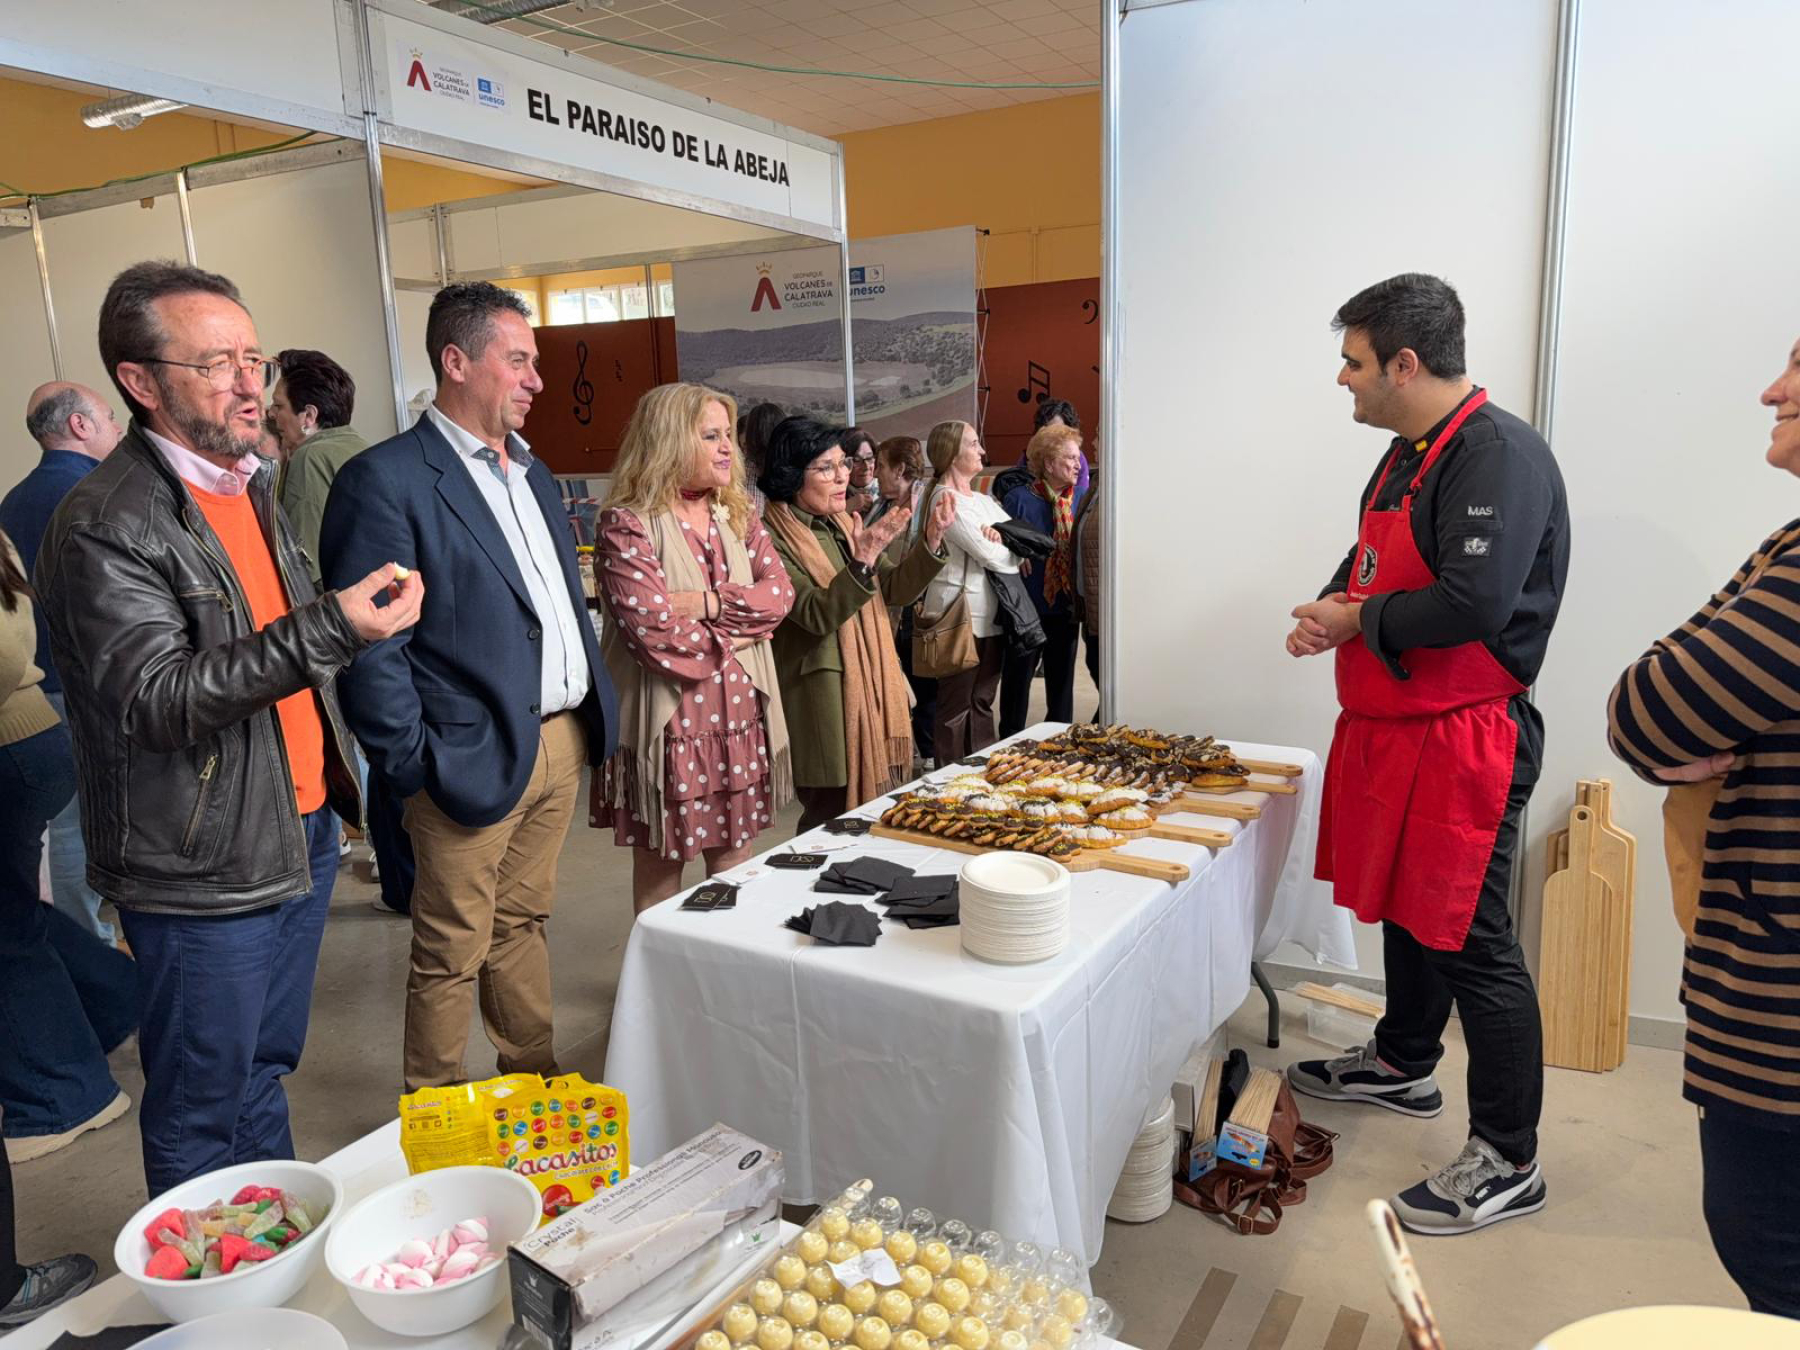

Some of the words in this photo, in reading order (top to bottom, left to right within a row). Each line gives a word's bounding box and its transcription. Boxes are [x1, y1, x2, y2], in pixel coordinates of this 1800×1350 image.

[432, 72, 463, 86] VOLCANES
[433, 80, 470, 96] CALATRAVA
[479, 94, 505, 106] unesco
[527, 88, 559, 126] EL
[566, 99, 666, 153] PARAISO
[672, 130, 699, 163] DE
[704, 139, 729, 171] LA
[734, 148, 790, 187] ABEJA
[784, 280, 826, 290] VOLCANES
[784, 290, 833, 302] CALATRAVA
[1467, 505, 1494, 516] MAS
[544, 1227, 576, 1247] Poche
